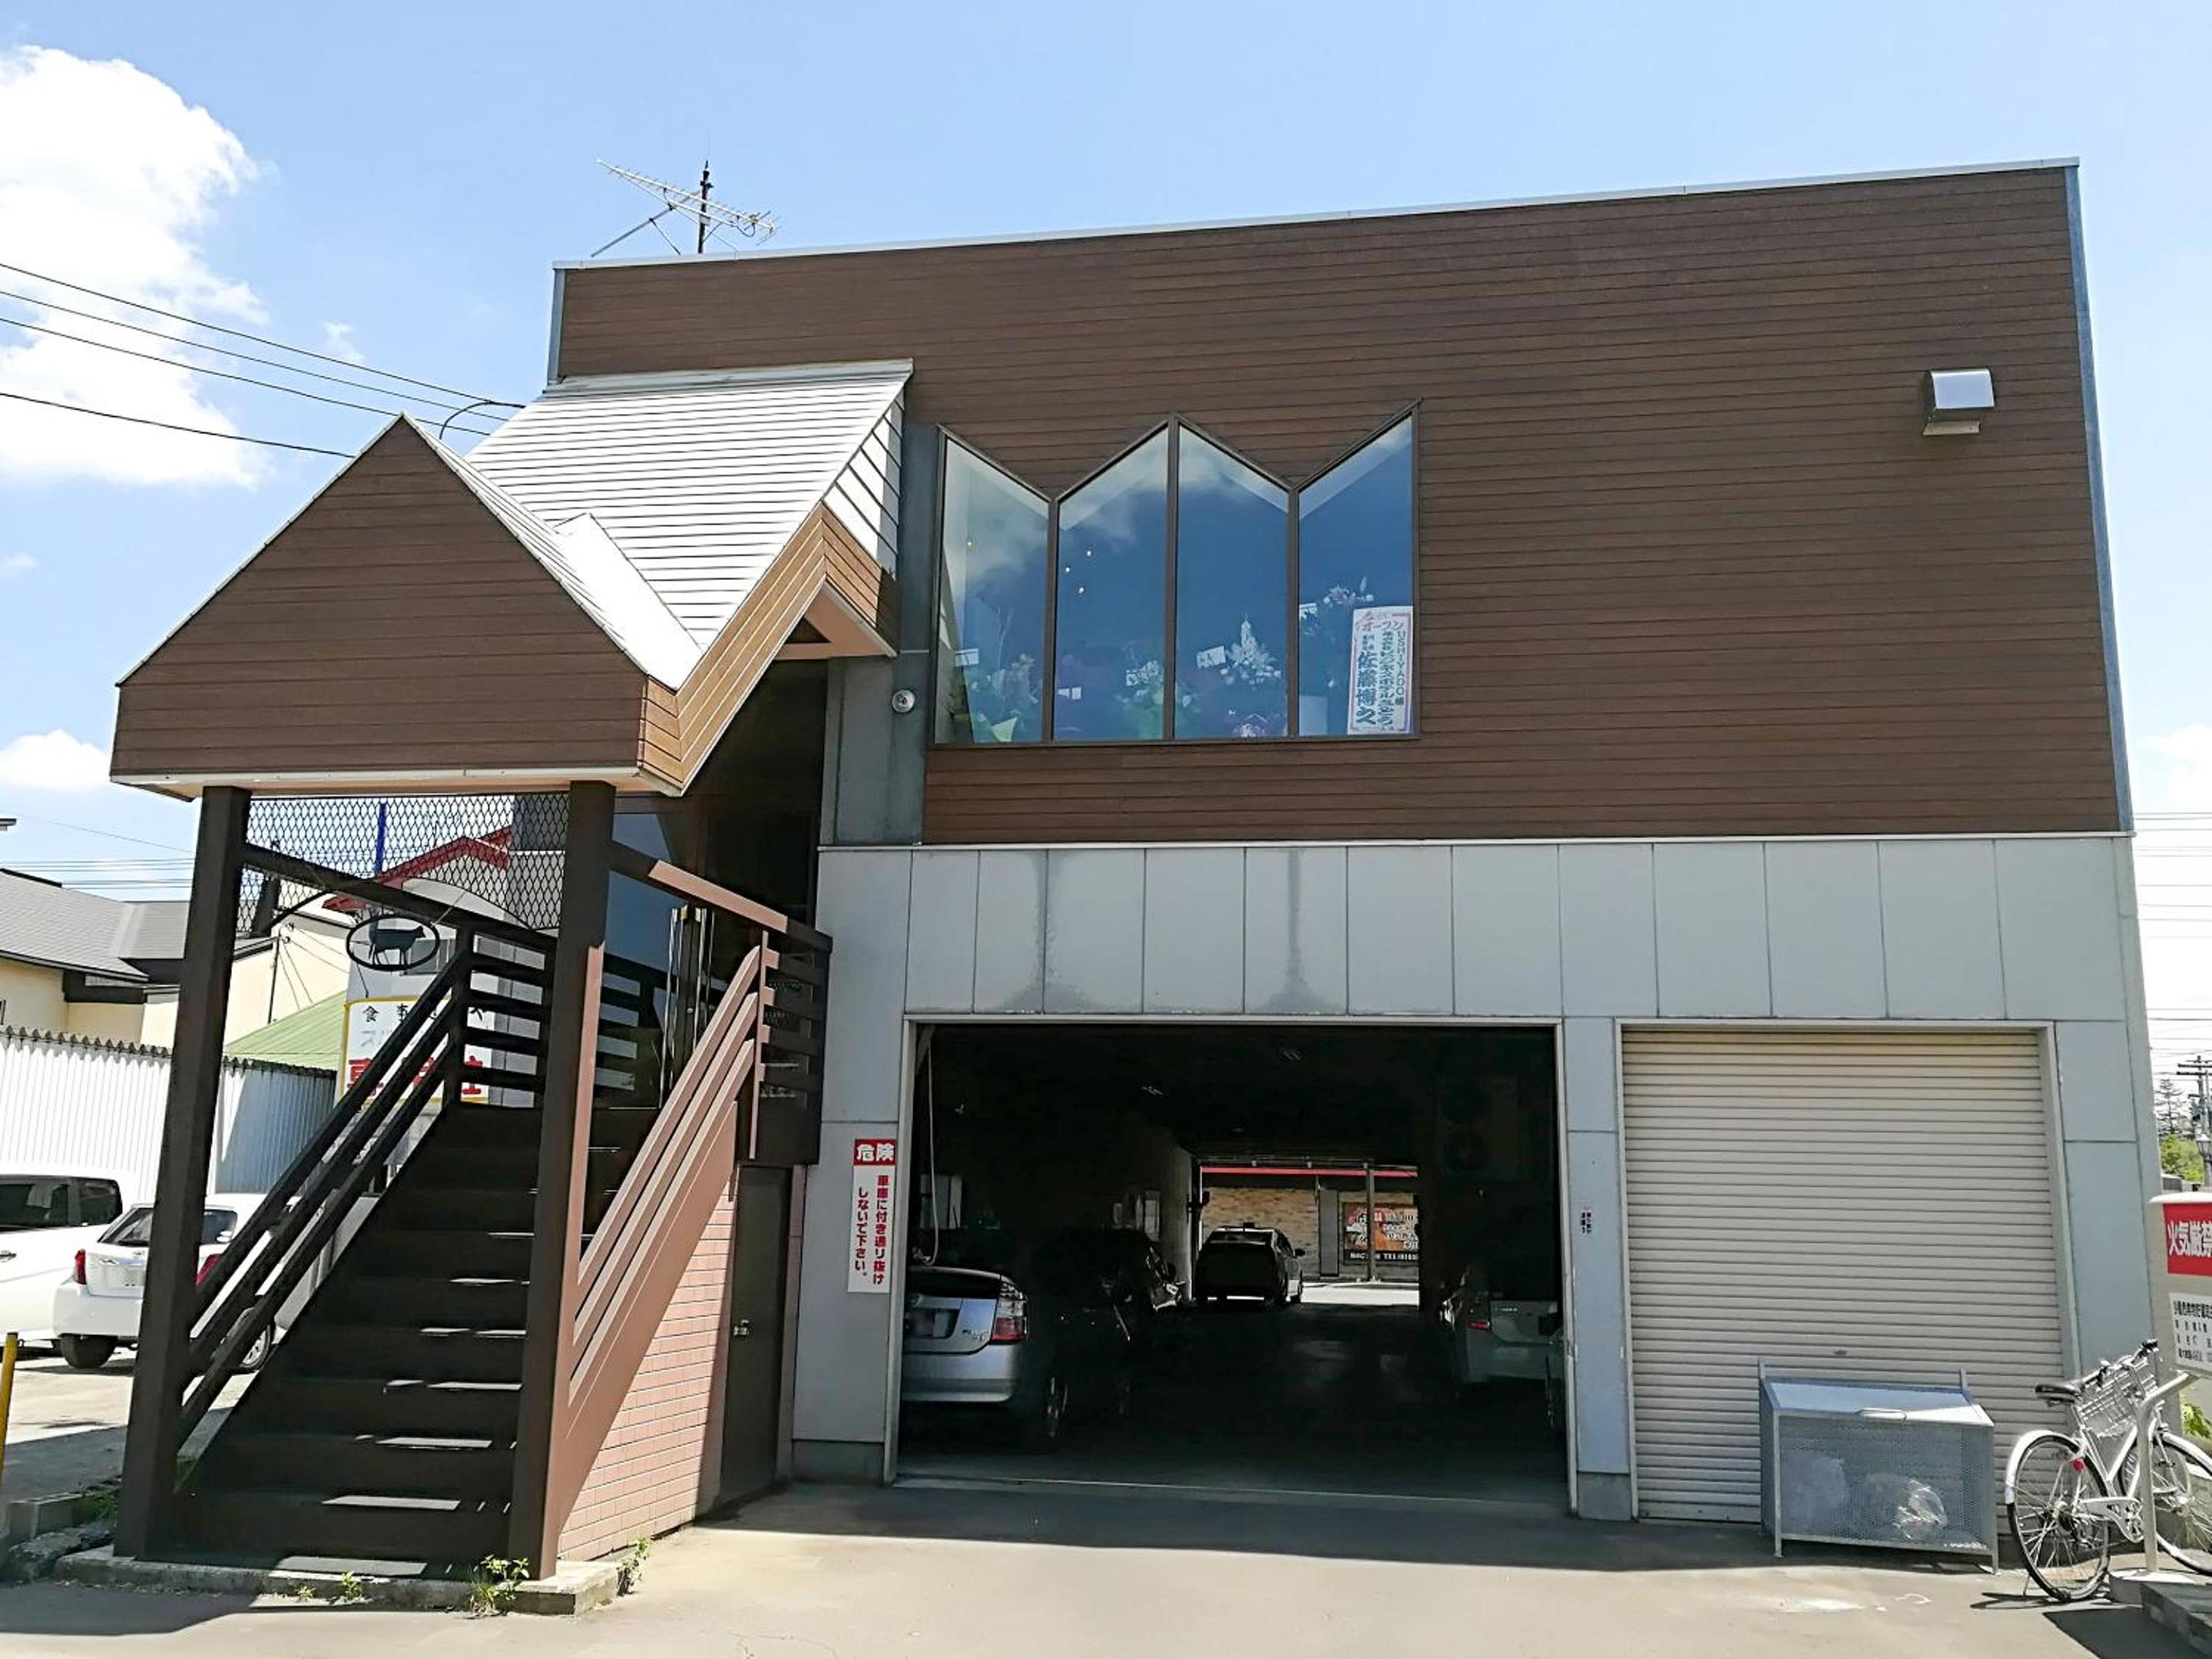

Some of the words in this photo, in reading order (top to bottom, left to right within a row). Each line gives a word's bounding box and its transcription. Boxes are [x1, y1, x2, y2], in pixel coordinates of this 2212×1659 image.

[856, 1143, 895, 1162] 危険
[855, 1187, 869, 1277] しないで下さい。
